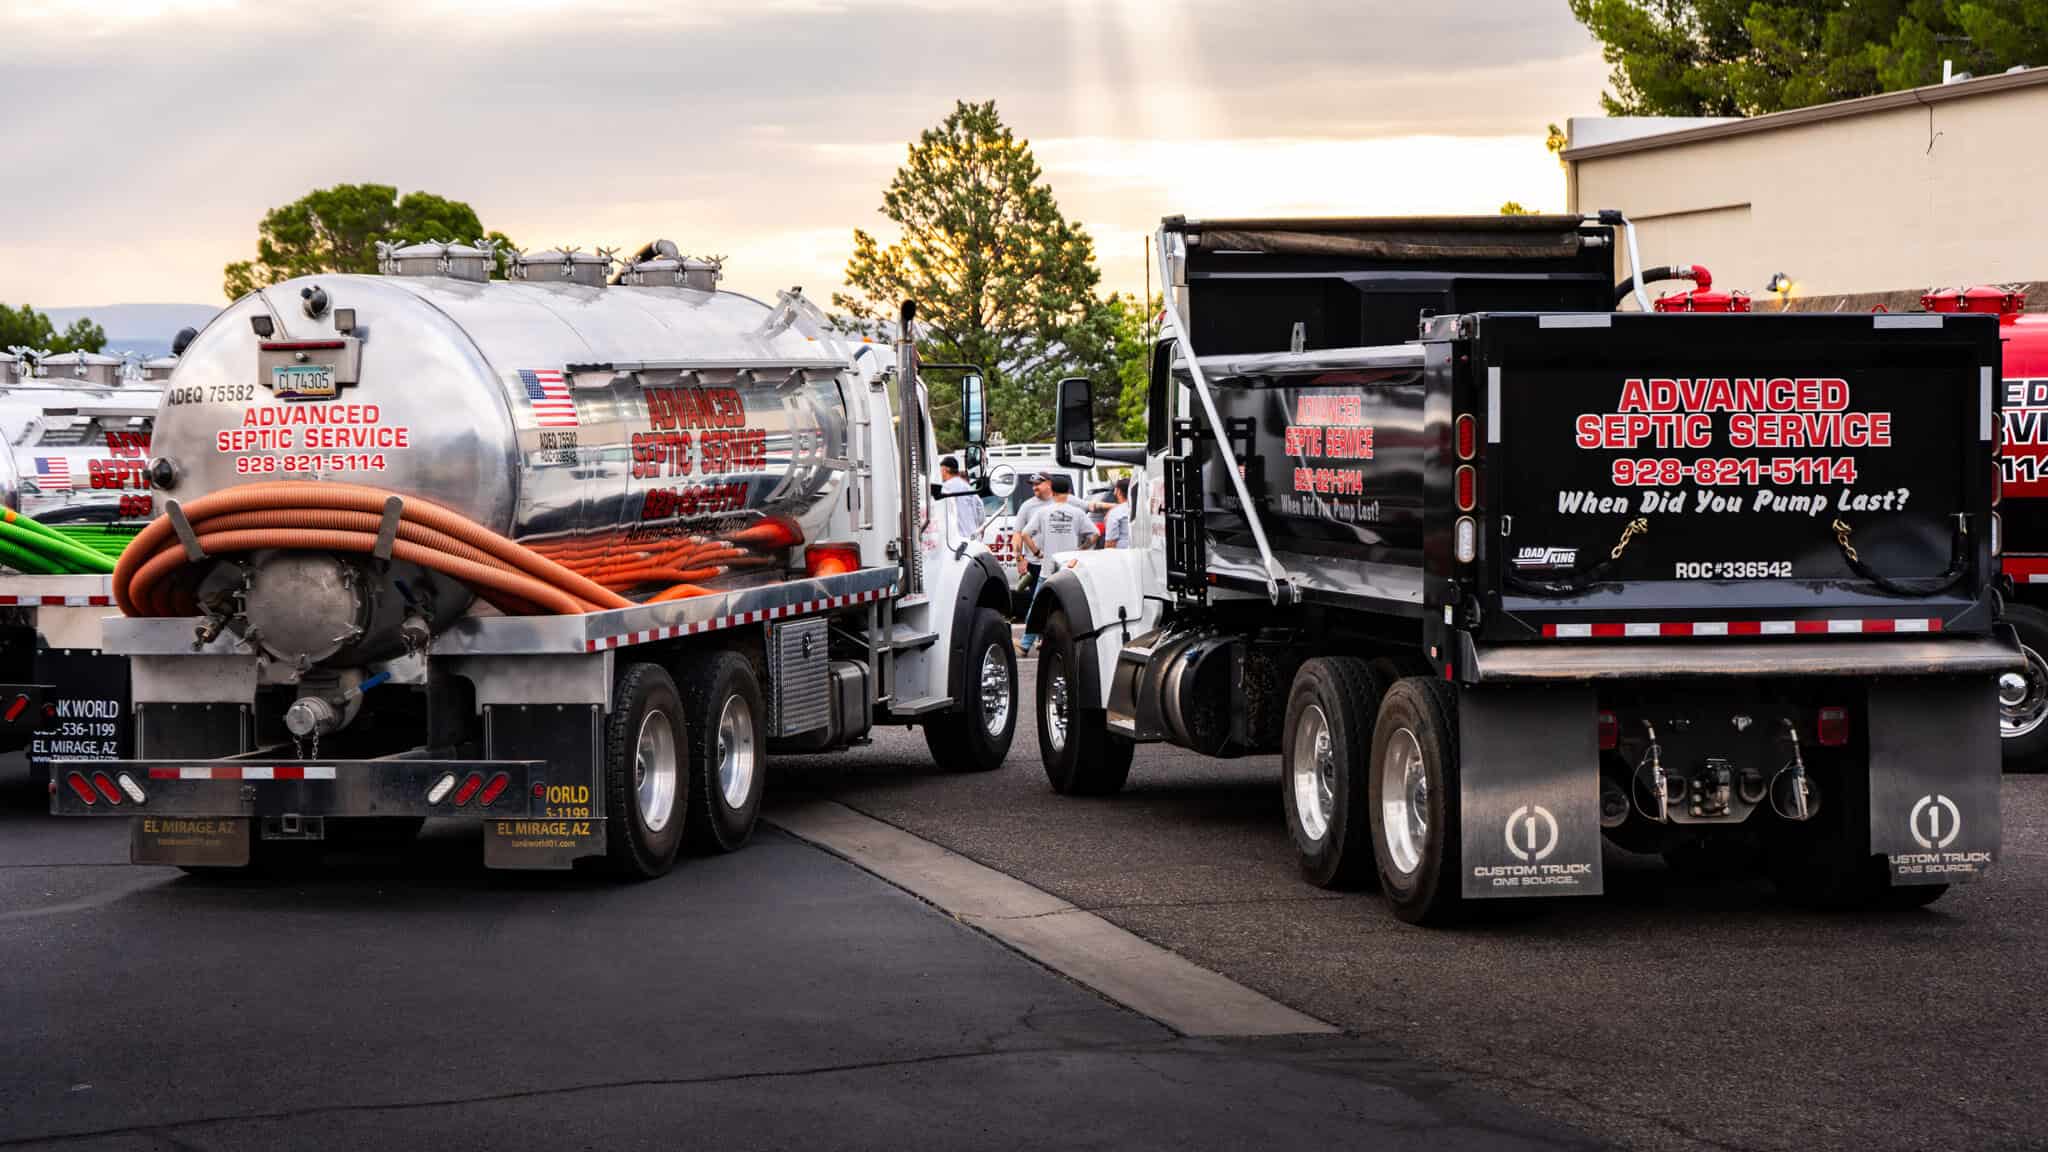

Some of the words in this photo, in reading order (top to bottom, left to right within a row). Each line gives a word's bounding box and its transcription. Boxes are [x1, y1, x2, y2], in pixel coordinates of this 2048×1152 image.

[167, 386, 204, 407] ADEQ
[208, 384, 255, 402] 75582
[1617, 378, 1850, 414] ADVANCED
[242, 404, 381, 428] ADVANCED
[643, 386, 746, 431] ADVANCED
[1296, 395, 1361, 425] ADVANCED
[216, 429, 294, 452] SEPTIC
[302, 427, 410, 450] SERVICE
[1284, 426, 1322, 457] SEPTIC
[1325, 426, 1374, 459] SERVICE
[1575, 413, 1713, 449] SEPTIC
[1728, 412, 1892, 448] SERVICE
[235, 452, 387, 474] 928-821-5114
[631, 430, 693, 480] SEPTIC
[700, 428, 767, 476] SERVICE
[1294, 467, 1363, 495] 928-821-5114
[1611, 456, 1858, 487] 928-821-5114
[641, 482, 748, 520] 928-821-5114
[1281, 494, 1300, 515] When
[1302, 495, 1316, 516] Did
[1333, 498, 1356, 522] Pump
[1357, 499, 1380, 522] Last?
[1557, 491, 1630, 514] When
[1639, 491, 1687, 514] Did
[1694, 489, 1743, 514] You
[1751, 489, 1828, 518] Pump
[1837, 487, 1911, 513] Last?
[1518, 547, 1545, 558] LOAD
[1549, 552, 1576, 563] KING
[1675, 561, 1793, 578] ROC#336542
[72, 699, 119, 718] WORLD
[32, 740, 49, 753] EL
[50, 740, 100, 755] MIRAGE,
[102, 741, 118, 754] AZ
[498, 822, 513, 835] EL
[572, 822, 591, 835] AZ
[1473, 865, 1538, 877] CUSTOM
[1541, 863, 1592, 875] TRUCK
[1888, 854, 1940, 865] USTOM
[1942, 852, 1992, 863] TRUCK
[1898, 865, 1923, 874] ONE
[1492, 877, 1520, 886] ONE
